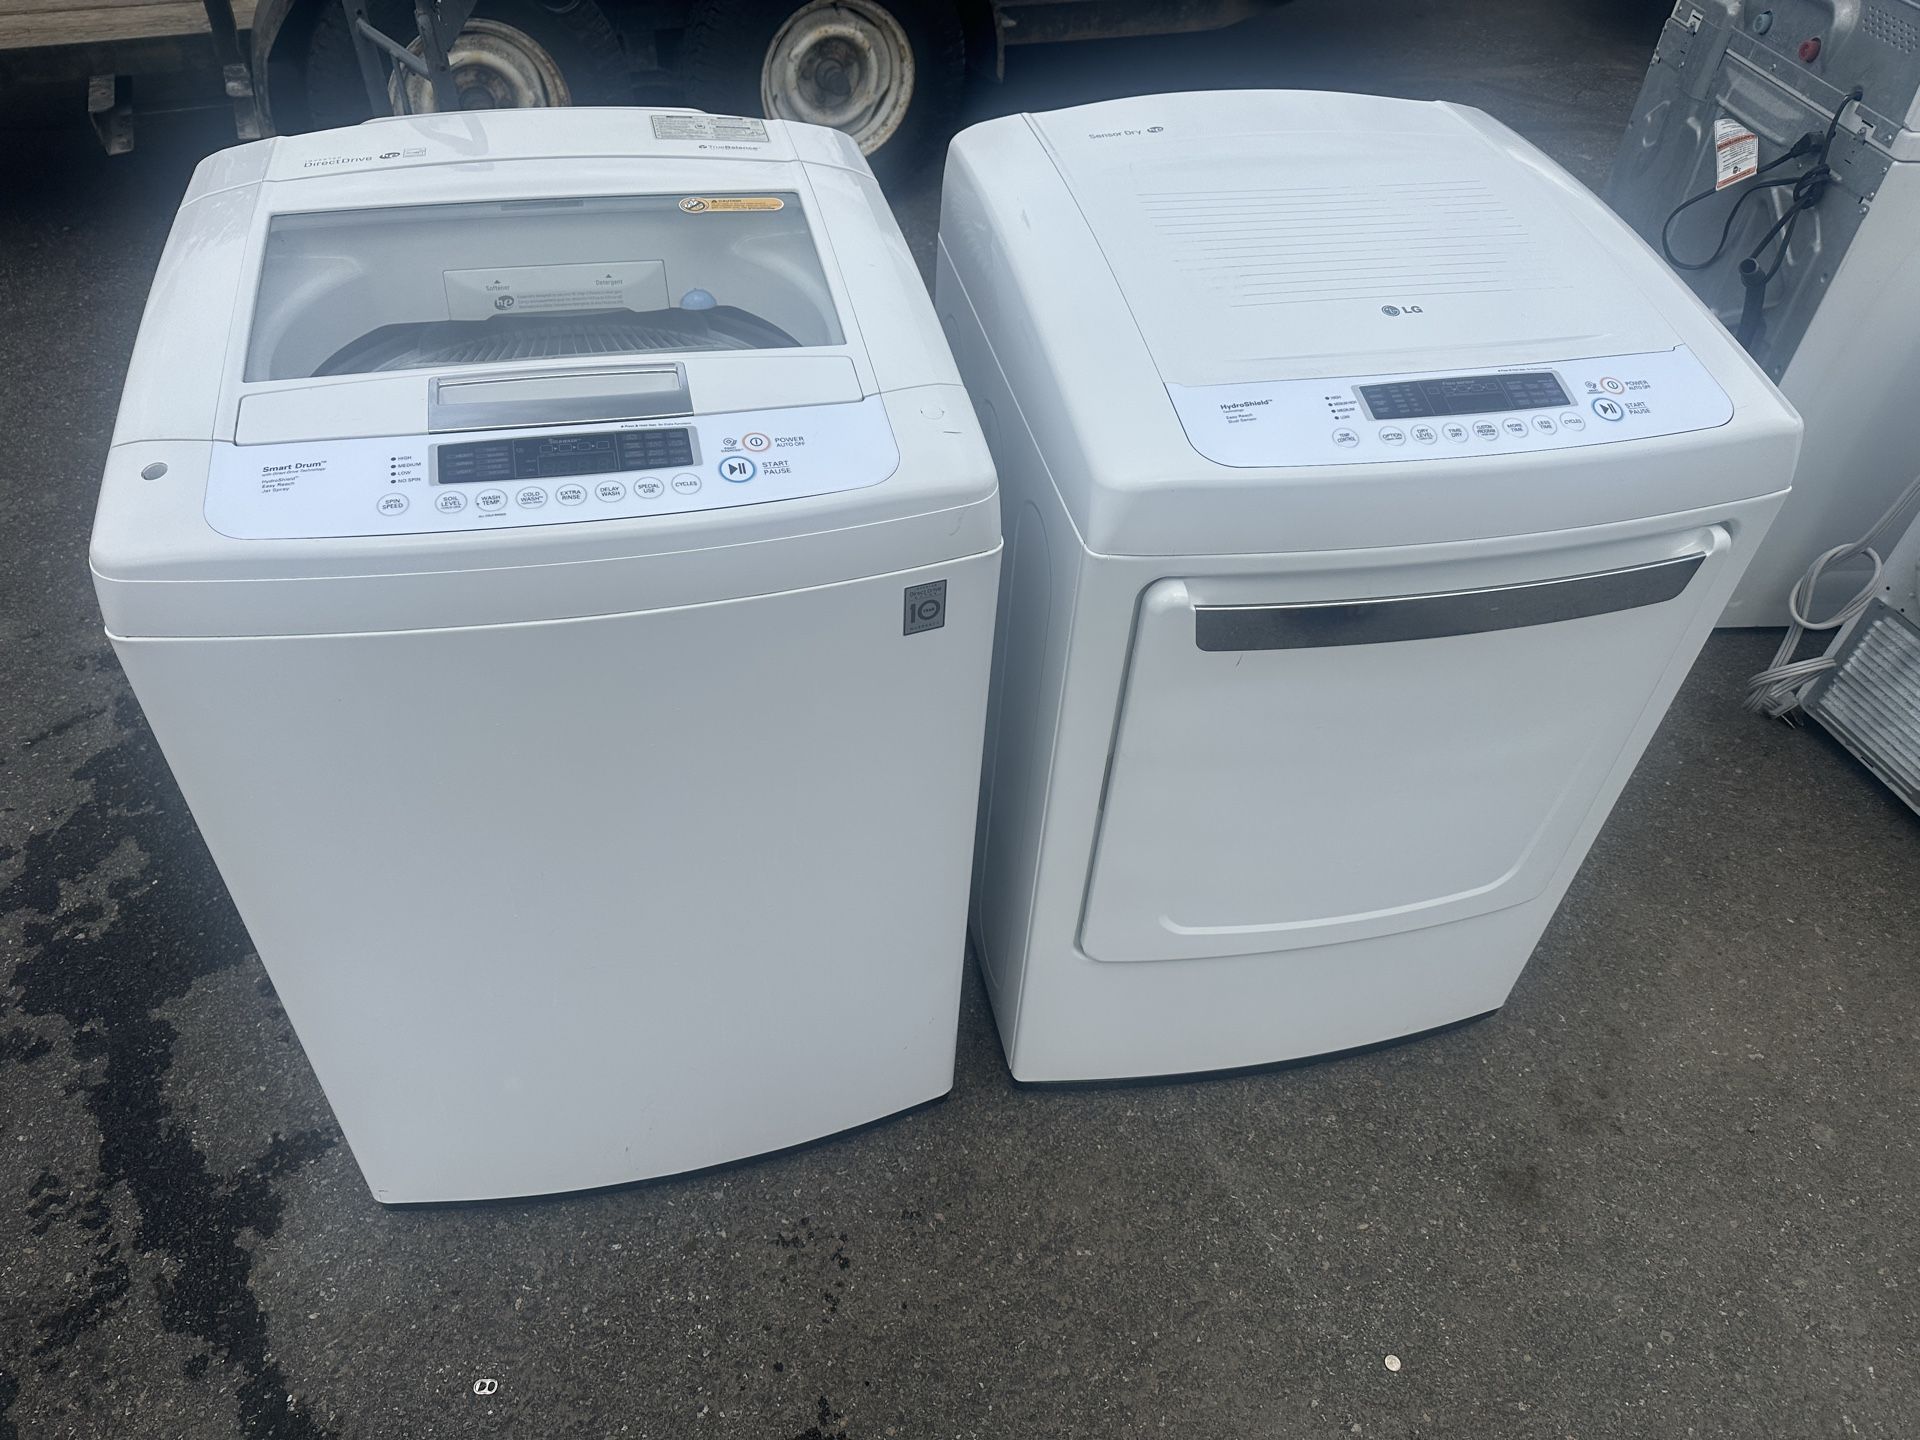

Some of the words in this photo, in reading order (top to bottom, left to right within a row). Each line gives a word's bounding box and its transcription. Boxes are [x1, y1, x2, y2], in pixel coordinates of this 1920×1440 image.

[1088, 131, 1121, 139] Sensor
[595, 279, 624, 287] Detergent
[485, 284, 511, 292] Softener
[1401, 305, 1424, 313] LG
[262, 464, 293, 473] Smart
[910, 599, 940, 624] 10
